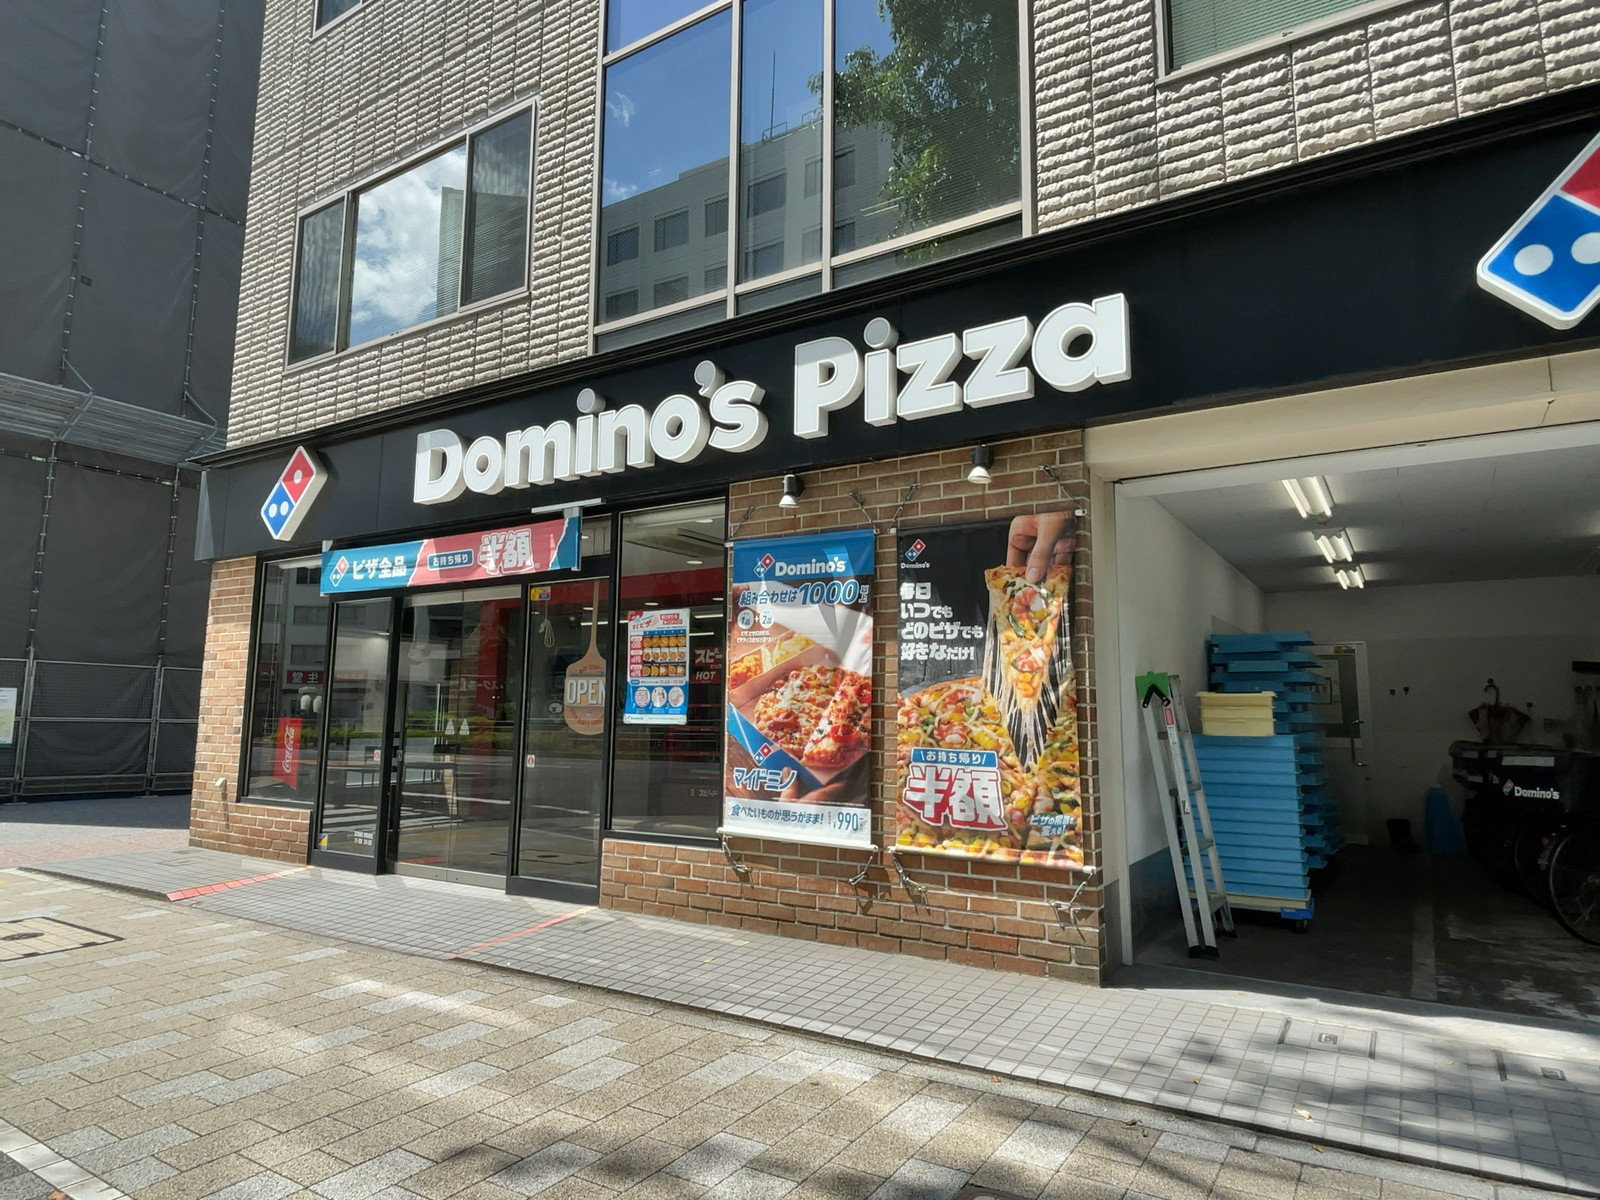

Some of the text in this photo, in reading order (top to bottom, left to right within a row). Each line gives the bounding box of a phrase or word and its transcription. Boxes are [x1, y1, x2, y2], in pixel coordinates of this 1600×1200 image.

[414, 293, 1131, 505] Domino's Pizza
[432, 555, 469, 568] お持ち帰り
[478, 529, 533, 574] 半額
[352, 556, 407, 580] ピザ全品
[775, 556, 846, 577] Domino's
[900, 561, 931, 569] Domino's
[900, 582, 931, 600] 毎日
[900, 602, 953, 619] いつでも
[901, 621, 984, 640] どのピザでも
[900, 642, 975, 661] 好きなだけ!
[695, 671, 716, 680] HOT
[566, 679, 606, 705] OPEN
[733, 767, 797, 791] マイドミノ
[903, 764, 1008, 831] 半額
[1514, 787, 1560, 800] Domino's
[731, 804, 824, 825] 食べたいものが思うがまま!
